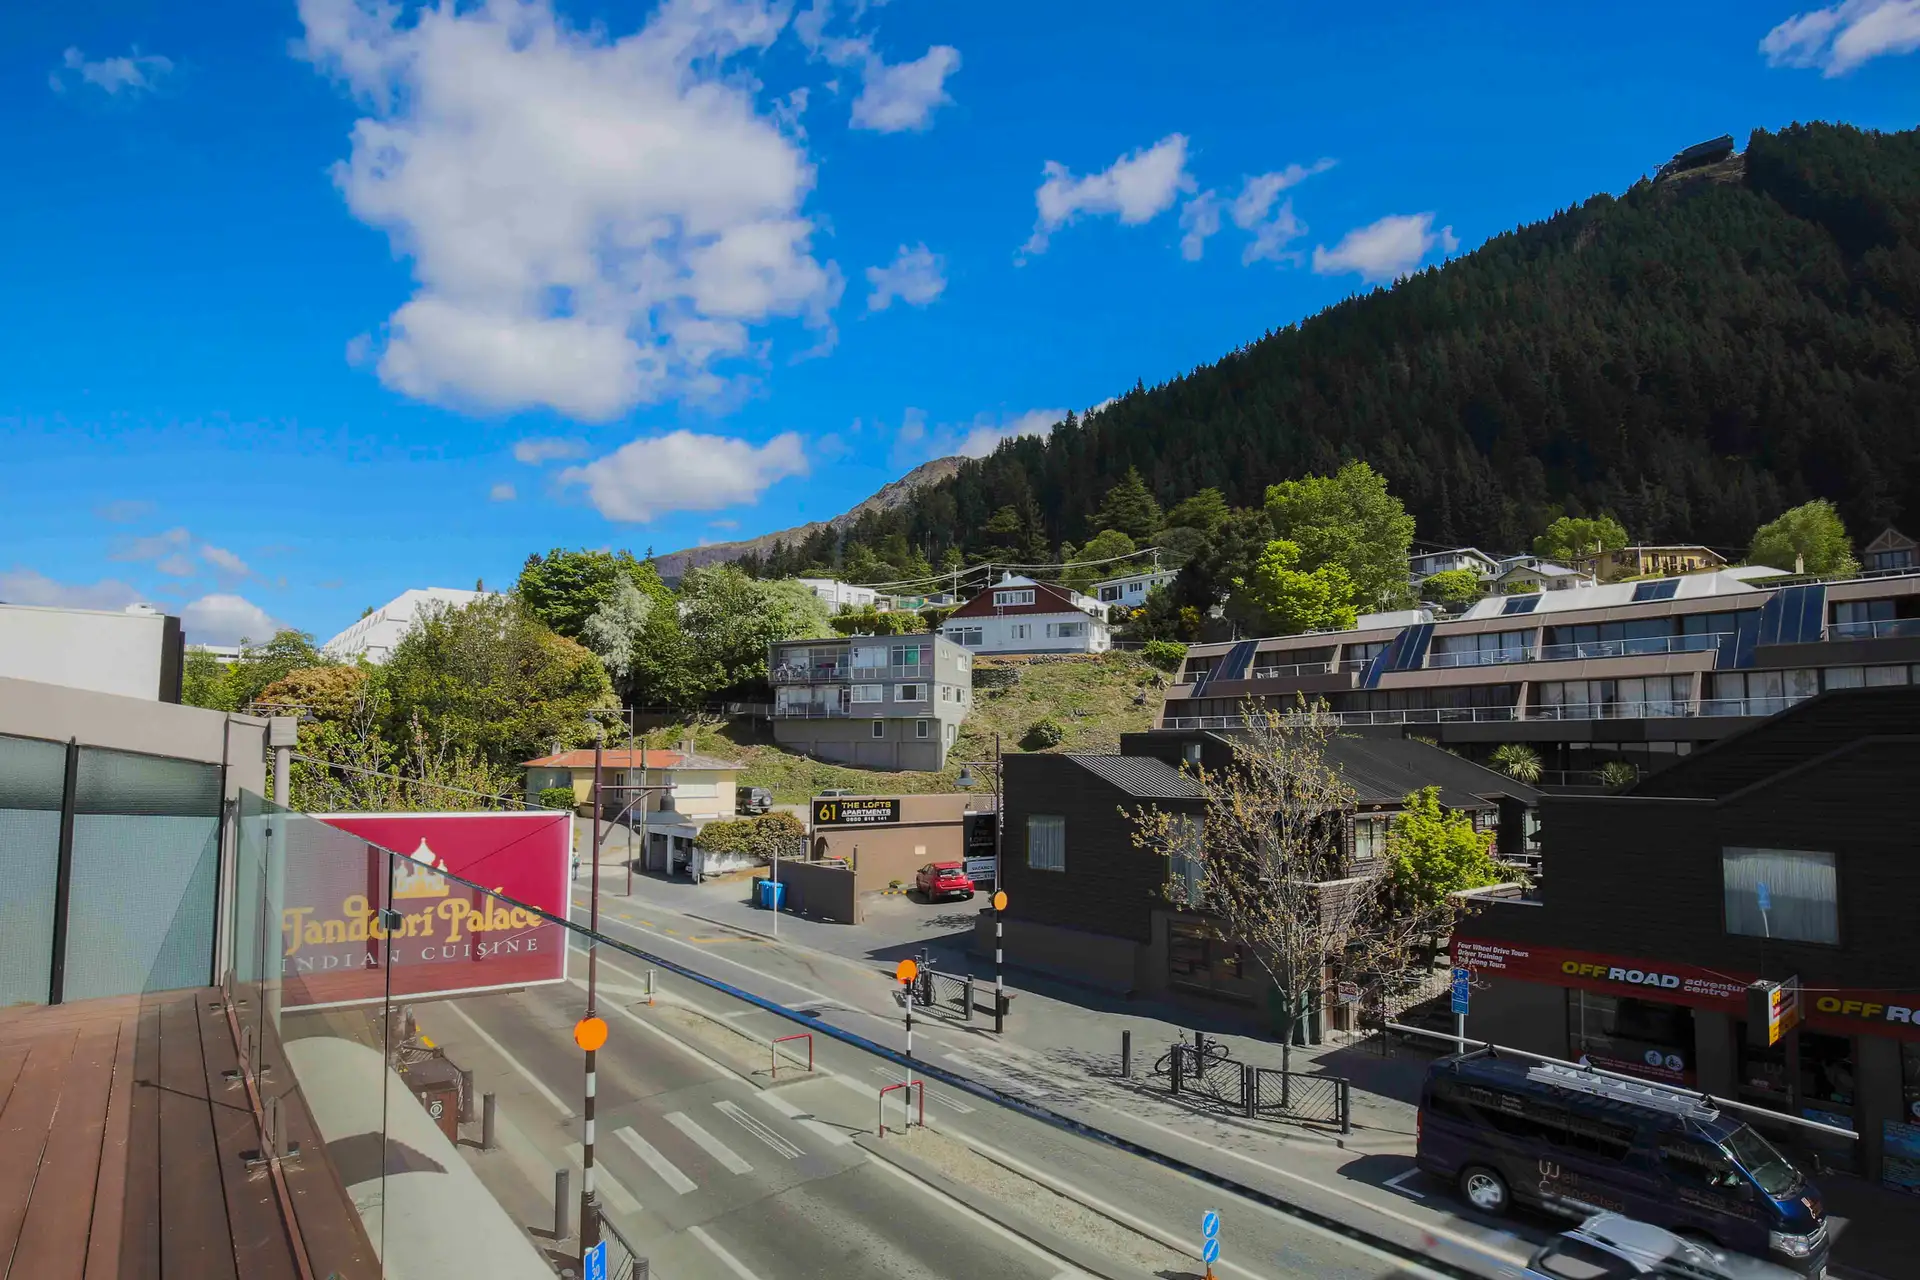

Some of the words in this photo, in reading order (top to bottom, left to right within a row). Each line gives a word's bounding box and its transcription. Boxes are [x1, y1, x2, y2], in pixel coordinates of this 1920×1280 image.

[819, 803, 837, 821] 61
[841, 801, 860, 809] THE
[841, 808, 892, 817] APARTMENTS
[282, 894, 434, 956] Tandoori
[437, 886, 543, 943] Palace
[421, 938, 538, 960] CUISINE
[1457, 941, 1472, 949] Four
[1472, 944, 1492, 952] Wheel
[1493, 946, 1510, 955] Drive
[1510, 949, 1529, 957] Tours
[1457, 948, 1477, 957] Driver
[1477, 951, 1503, 962] Training
[1489, 960, 1506, 969] Tours
[1562, 961, 1608, 978] OFF
[1608, 967, 1680, 989] ROAD
[1683, 985, 1730, 998] centre
[1684, 977, 1747, 994] adventur
[1815, 996, 1884, 1017] OFF
[592, 1249, 599, 1267] P
